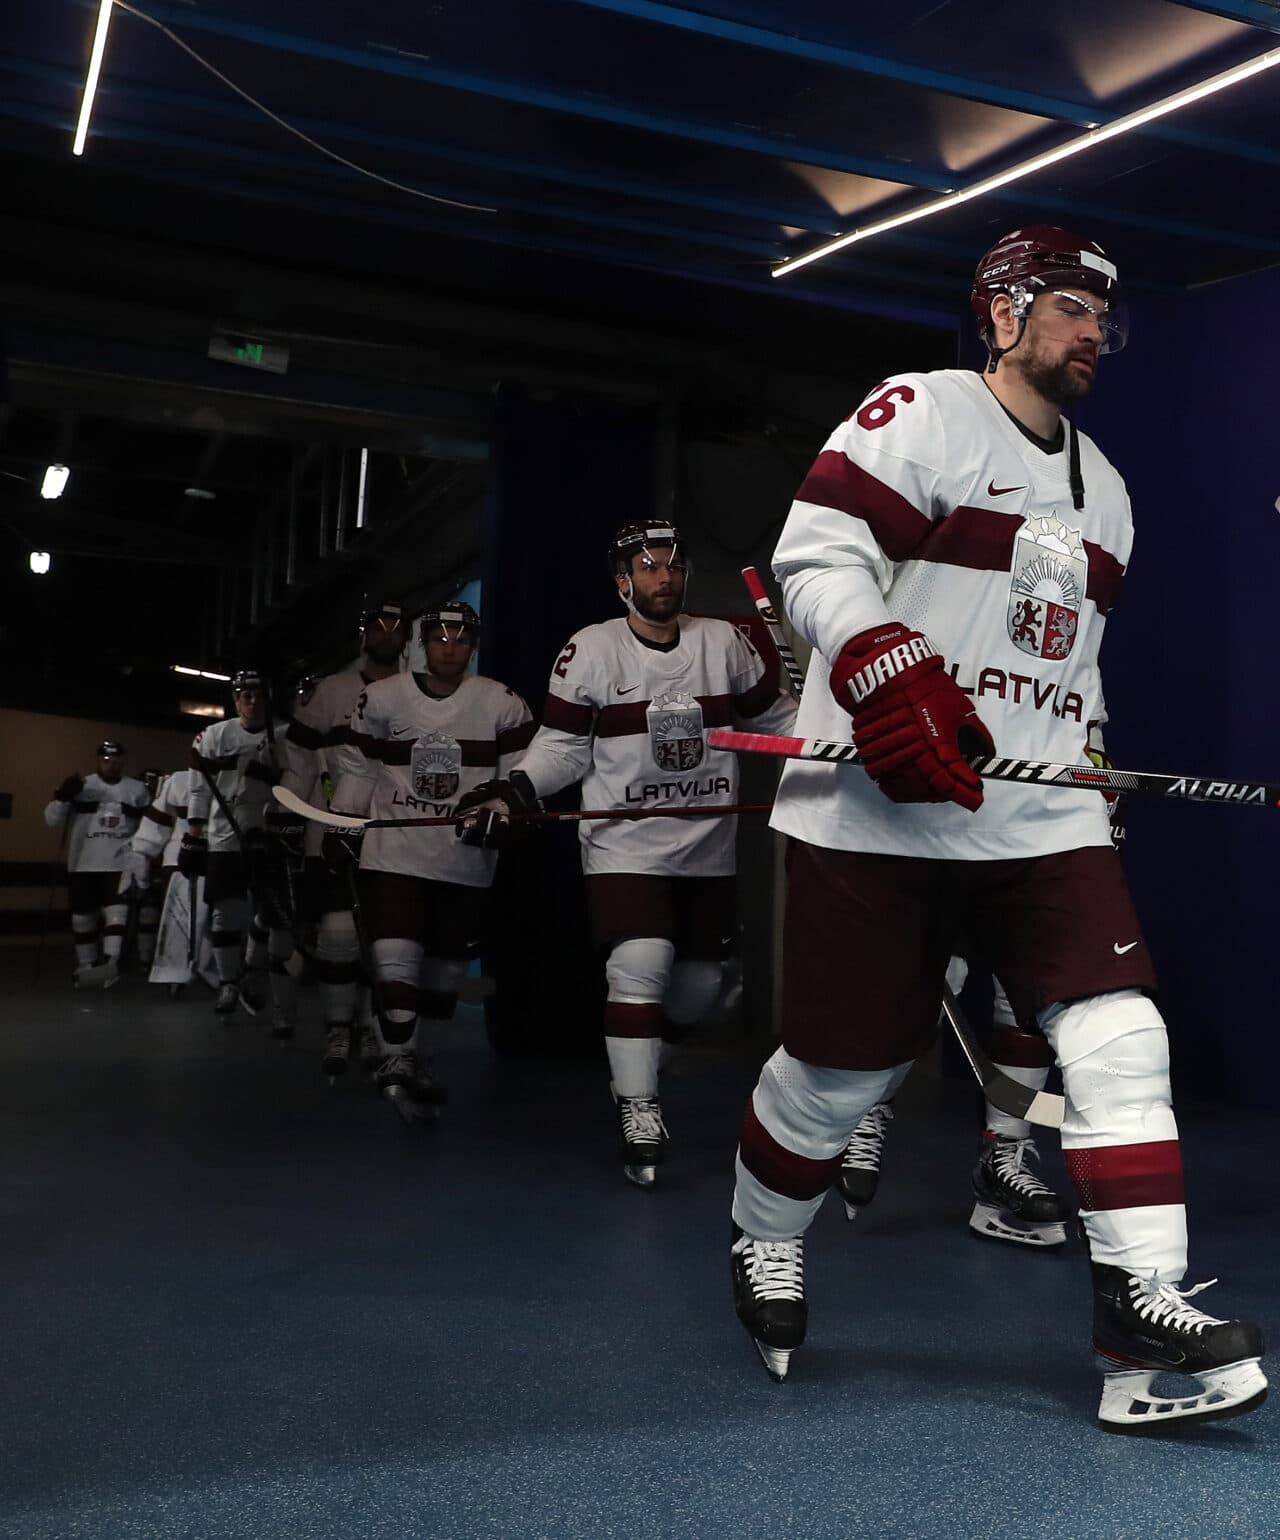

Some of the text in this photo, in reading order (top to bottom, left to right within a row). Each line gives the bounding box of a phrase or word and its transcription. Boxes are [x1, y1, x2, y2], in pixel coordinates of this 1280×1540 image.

[982, 263, 1011, 279] CCM
[842, 381, 915, 431] 6
[847, 636, 940, 704] WARRI
[625, 776, 731, 803] LATVIJA
[1166, 778, 1267, 804] ALPHA
